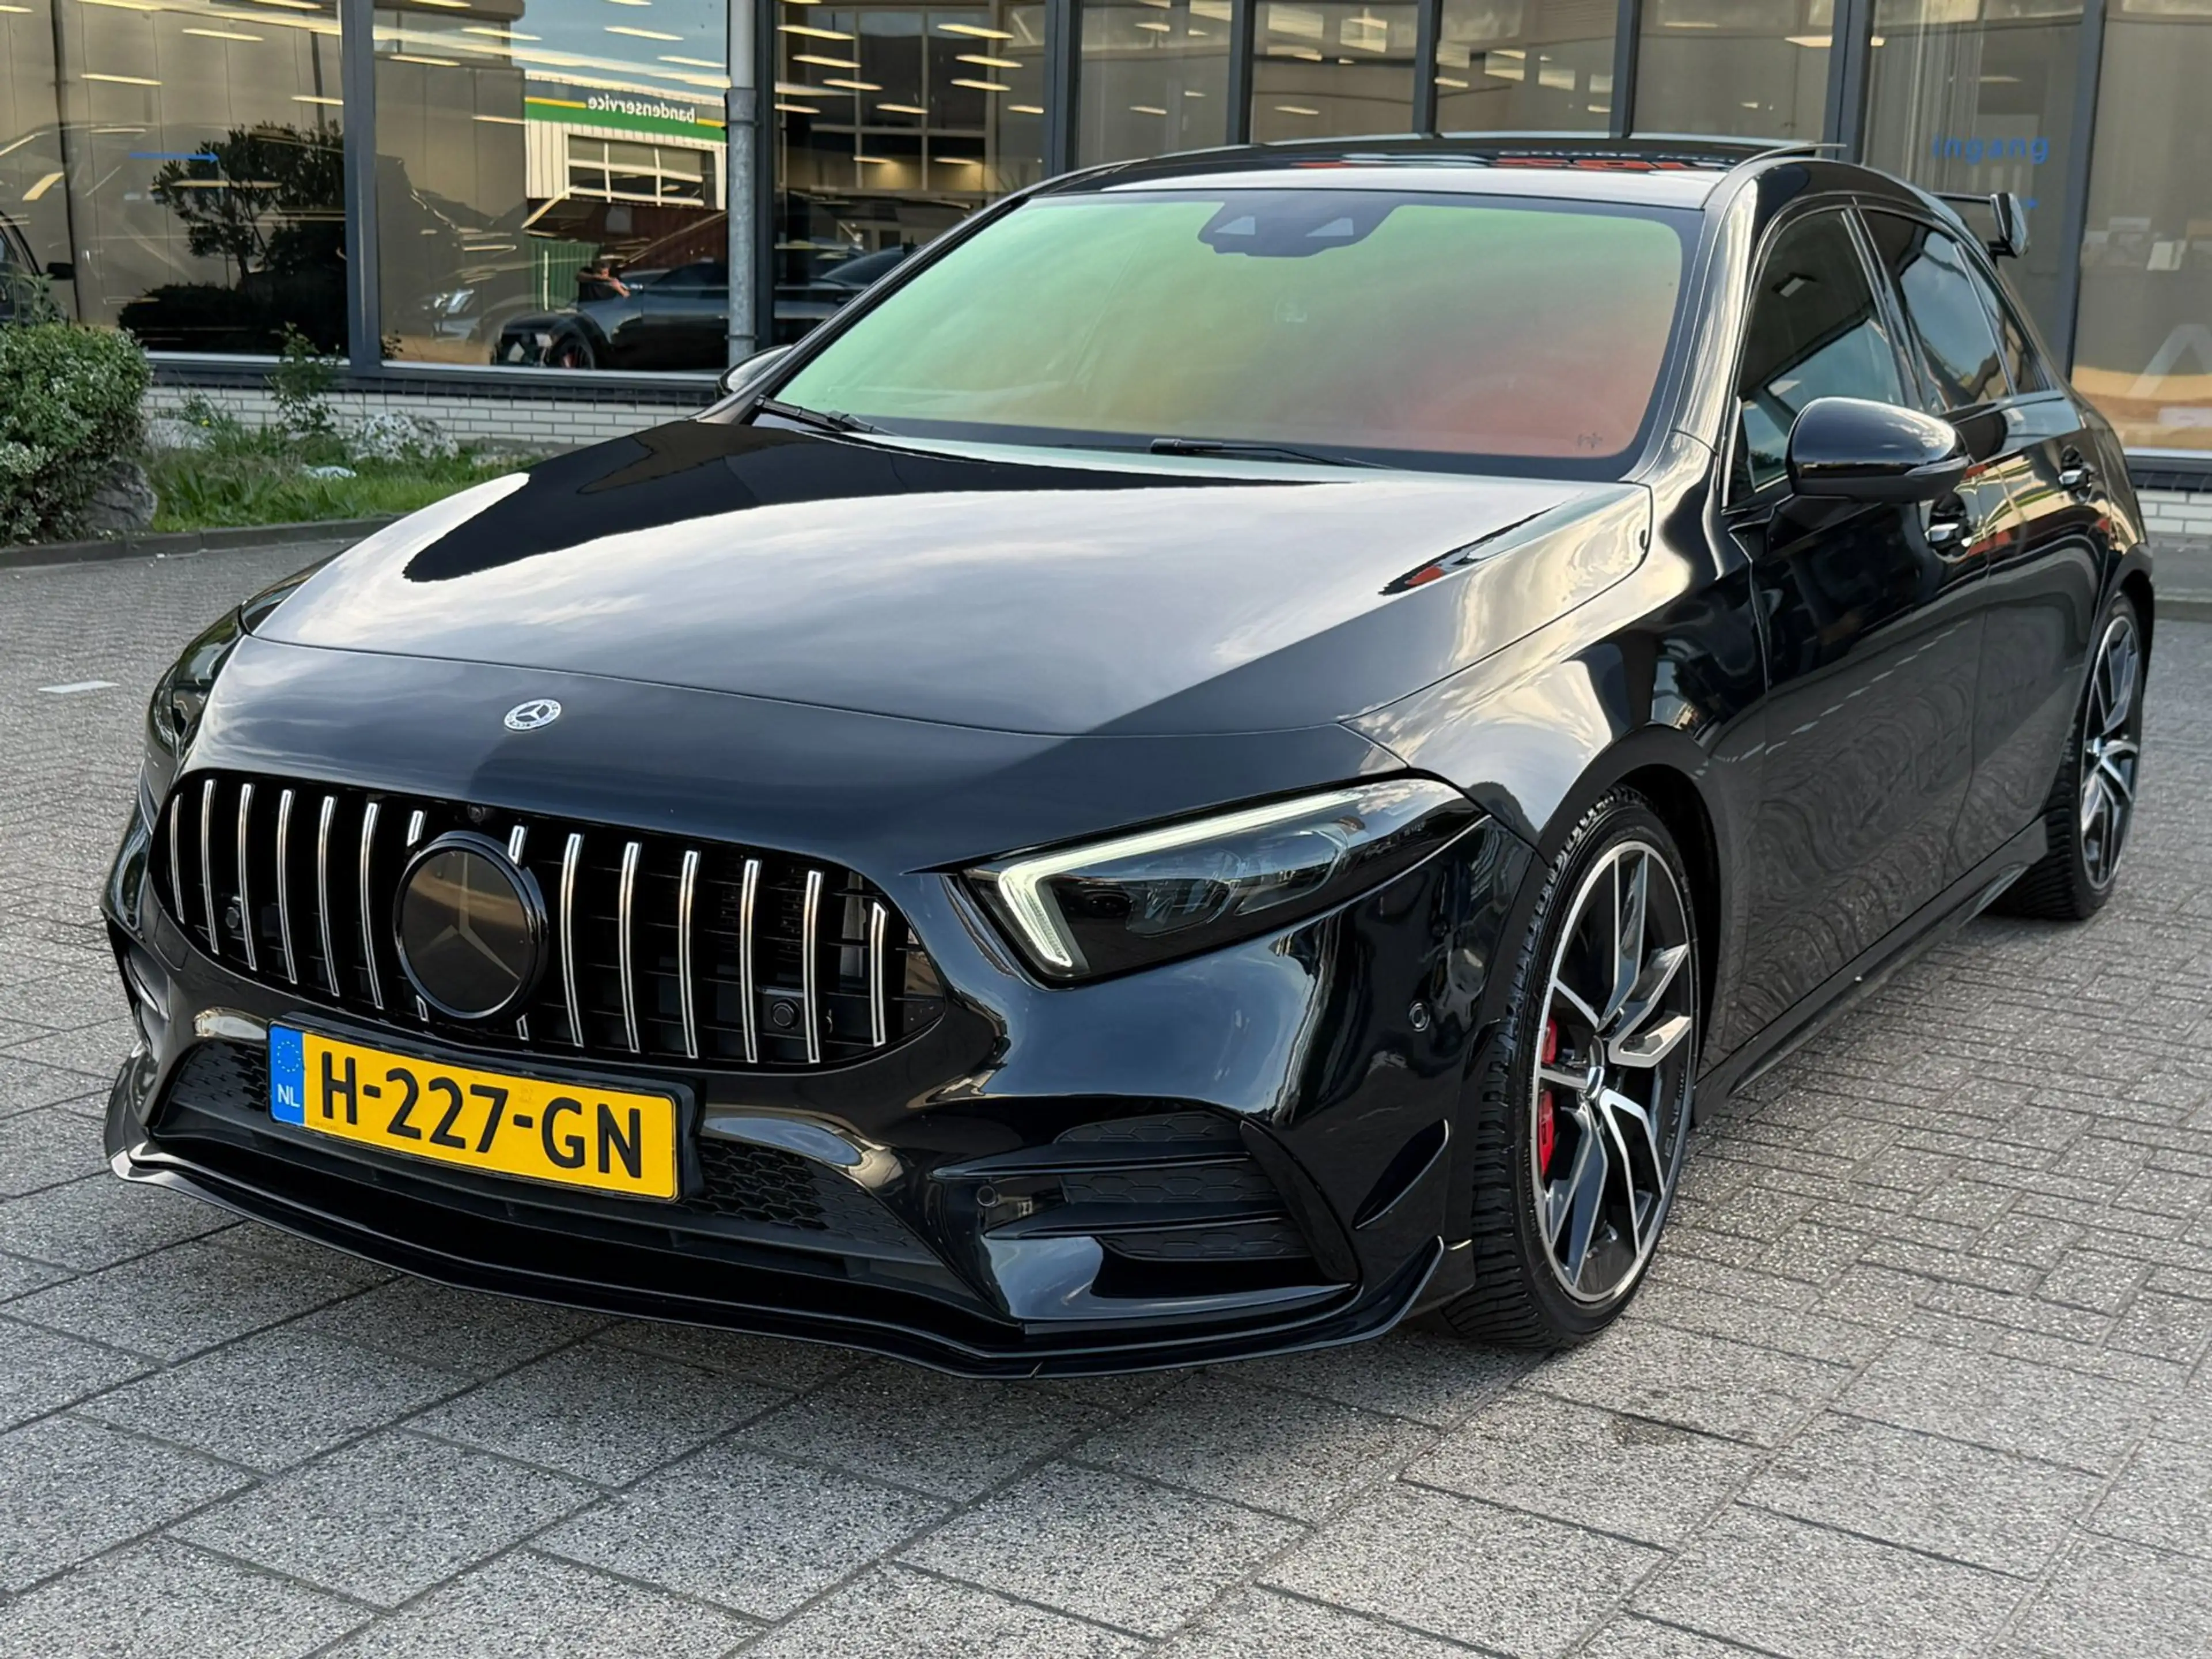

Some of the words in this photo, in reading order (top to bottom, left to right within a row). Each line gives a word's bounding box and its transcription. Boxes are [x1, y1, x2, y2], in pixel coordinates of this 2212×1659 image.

[1933, 135, 2050, 165] ingang
[277, 1083, 300, 1108] NL
[321, 1051, 642, 1179] H-227-GN
